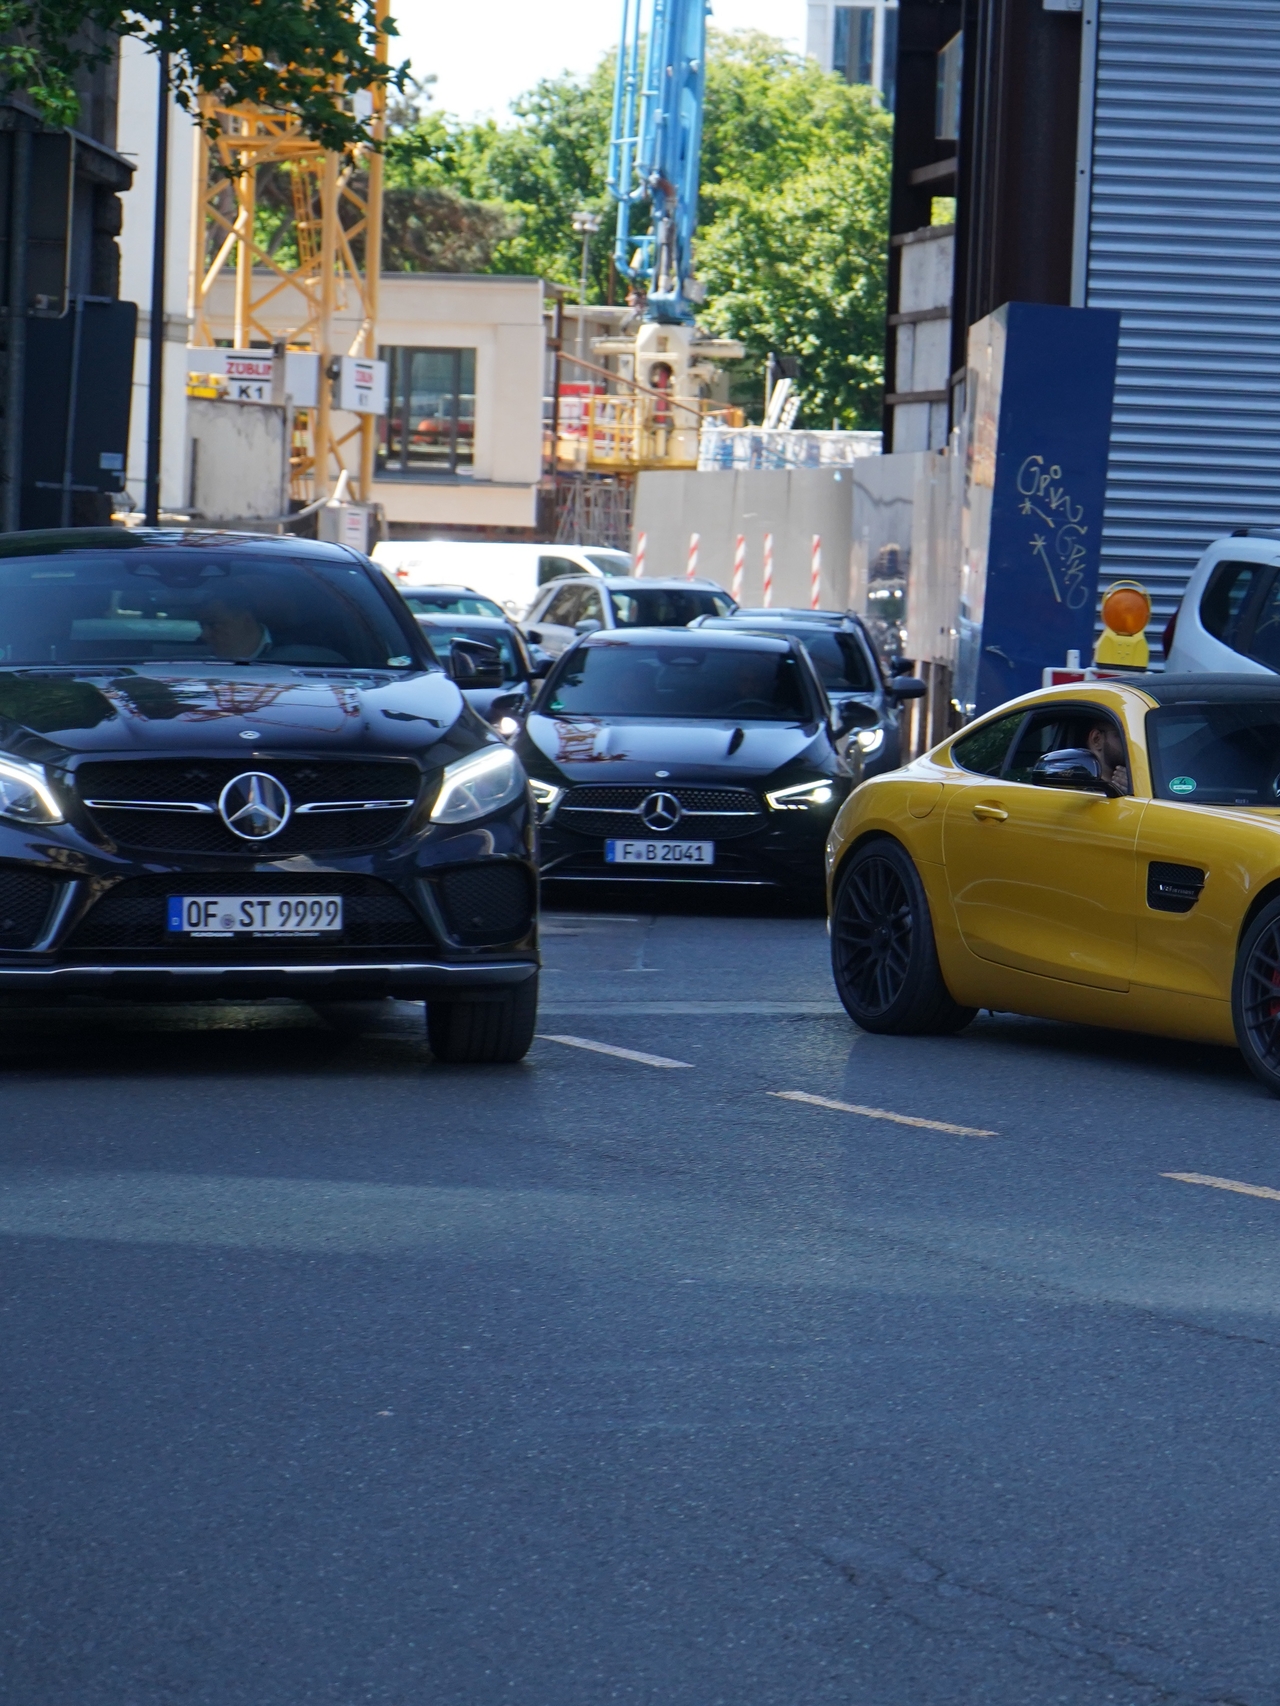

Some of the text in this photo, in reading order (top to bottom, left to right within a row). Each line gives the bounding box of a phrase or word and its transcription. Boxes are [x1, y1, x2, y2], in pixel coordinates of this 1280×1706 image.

[623, 843, 705, 862] F B 2041
[187, 900, 338, 927] OF ST 9999
